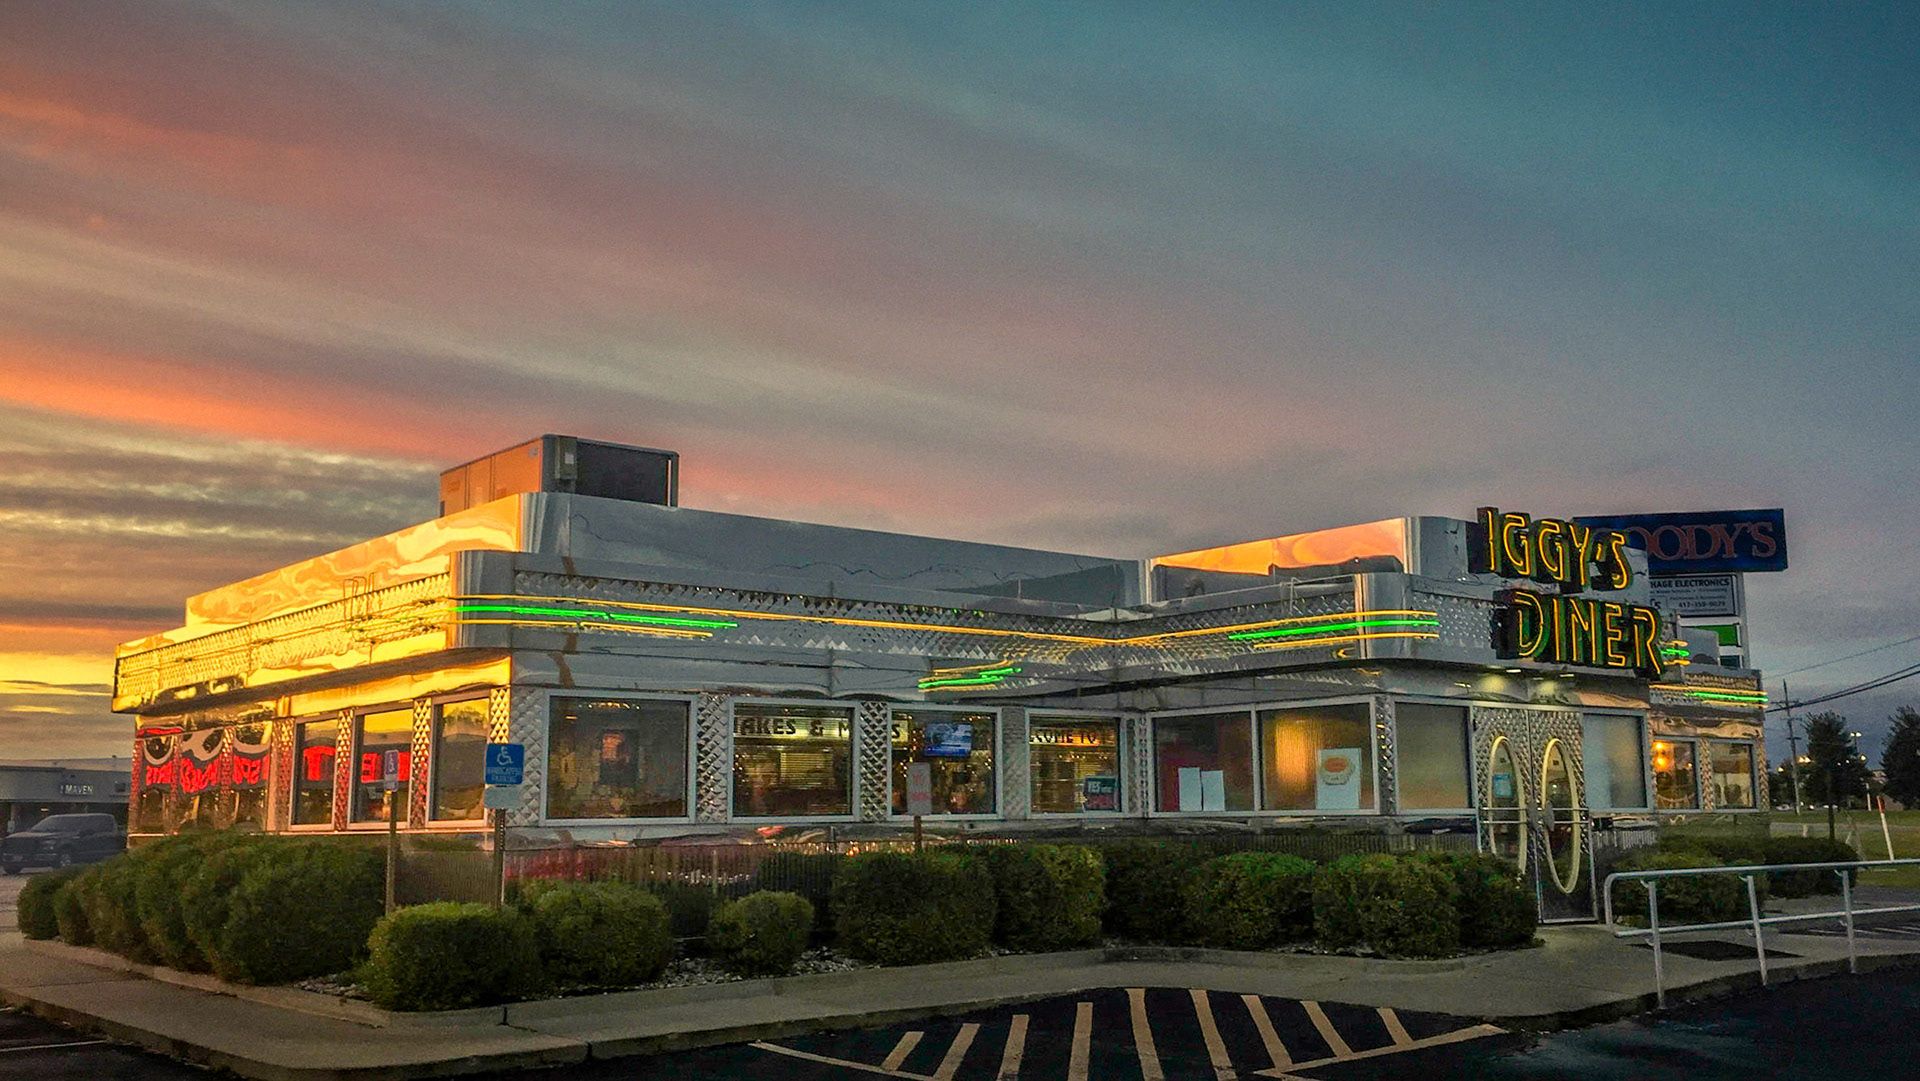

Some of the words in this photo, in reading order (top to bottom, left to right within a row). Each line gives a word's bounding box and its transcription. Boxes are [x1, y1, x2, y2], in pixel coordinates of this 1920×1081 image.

[1482, 509, 1631, 590] IGGY'S
[1594, 522, 1777, 561] ODY'S
[1649, 580, 1673, 588] HAGE
[1675, 578, 1730, 587] ELECTRONICS
[1502, 590, 1662, 676] DINER
[65, 784, 94, 795] MAVEN
